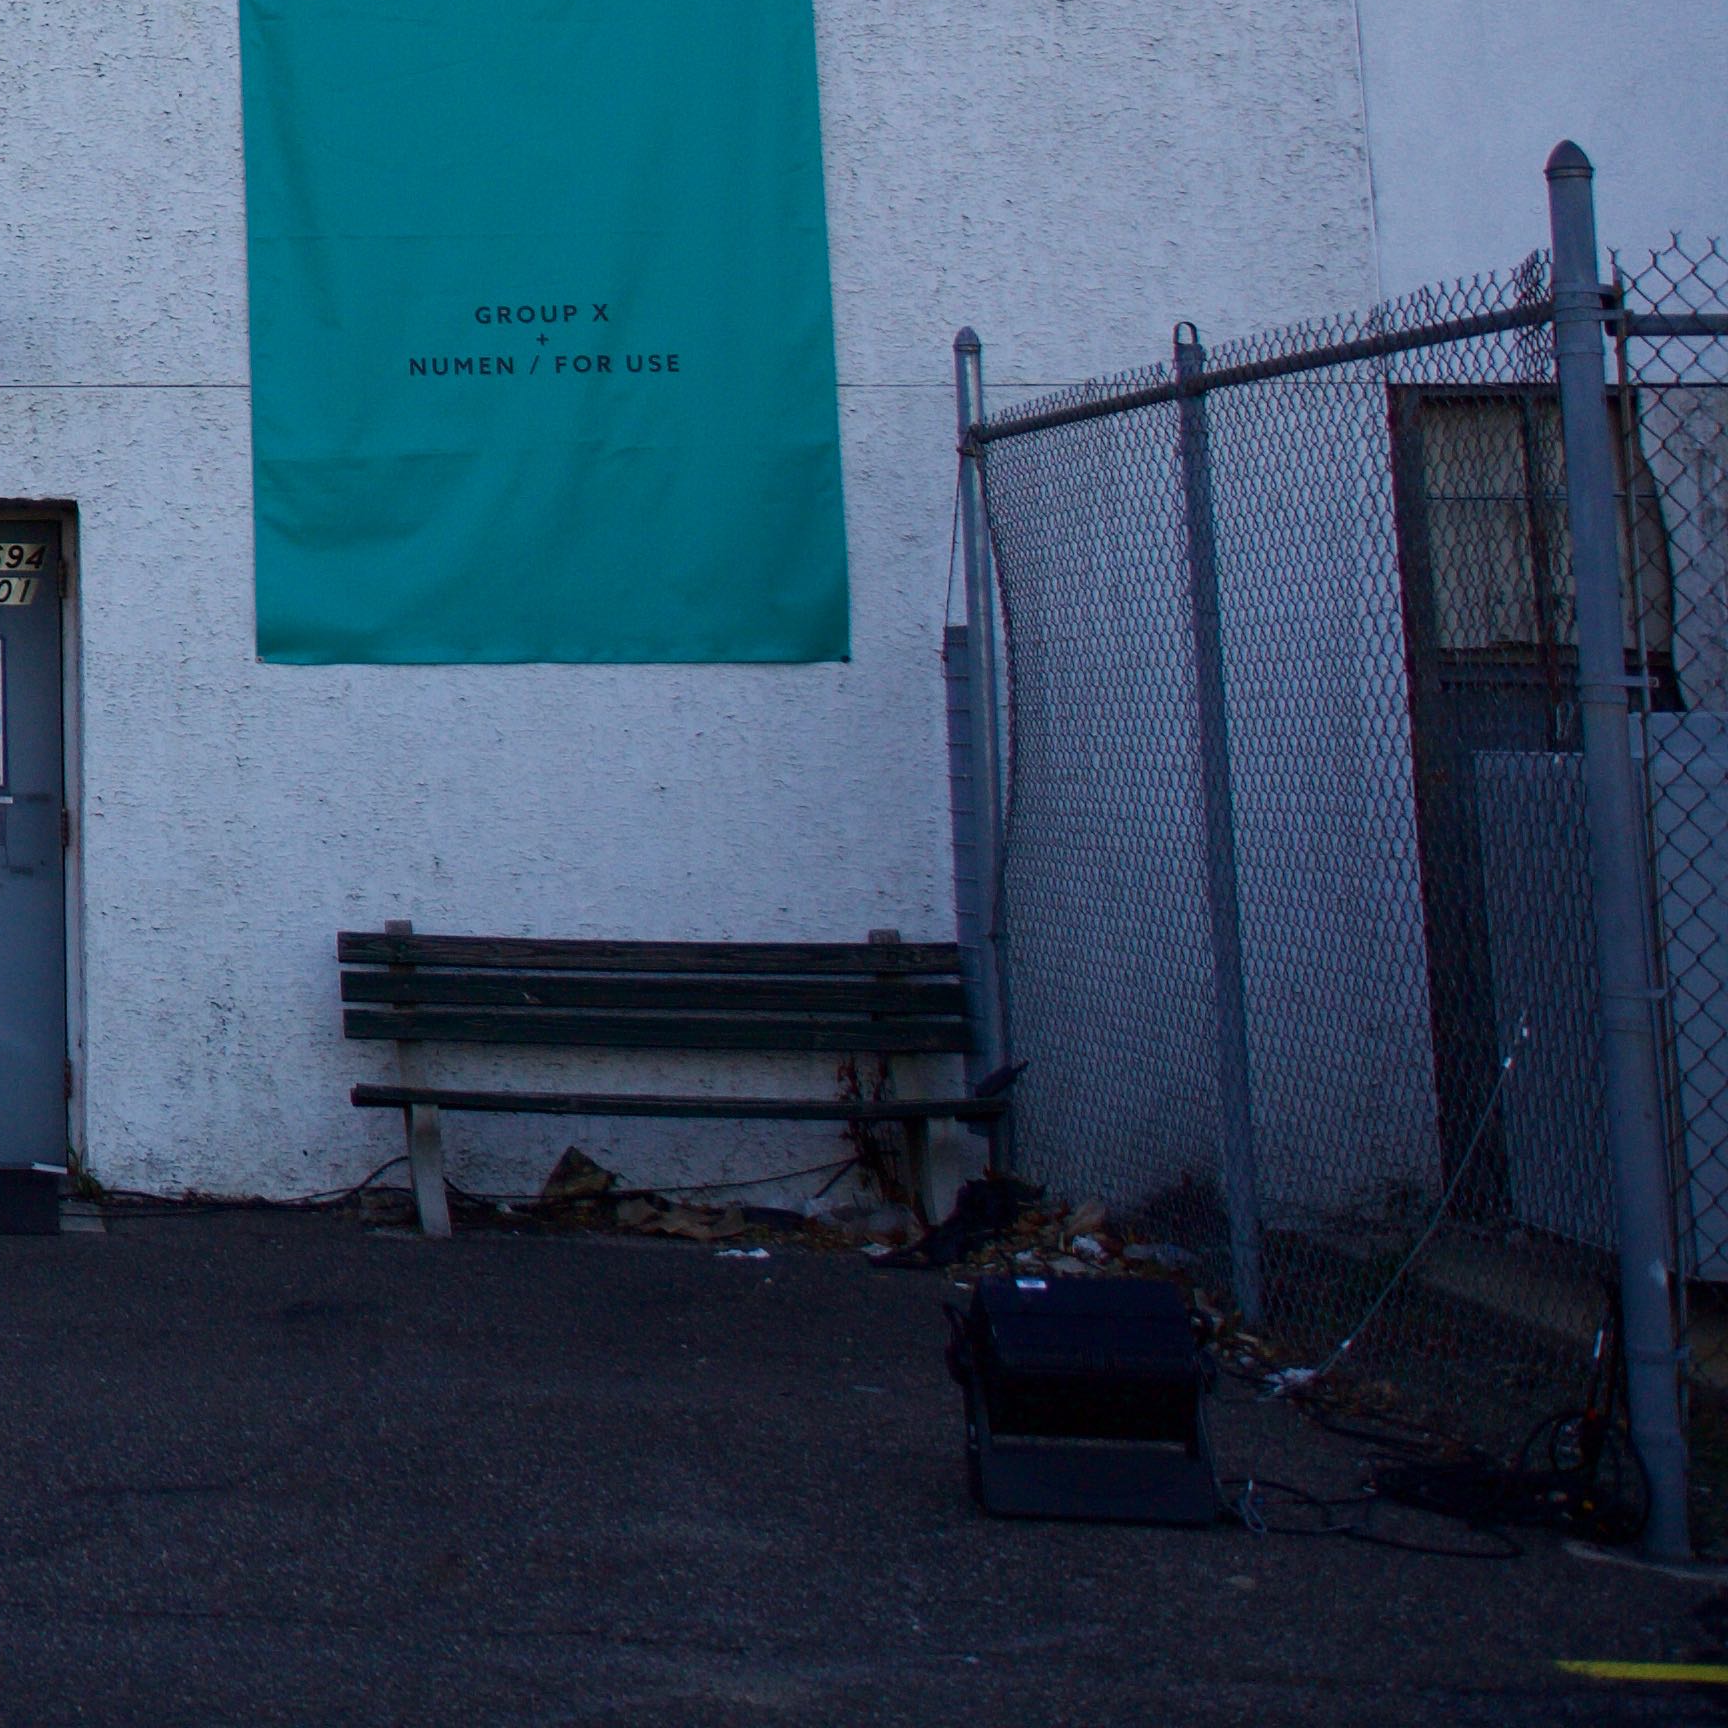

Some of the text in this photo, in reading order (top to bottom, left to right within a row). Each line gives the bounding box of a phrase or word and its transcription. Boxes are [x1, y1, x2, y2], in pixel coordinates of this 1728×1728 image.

[474, 303, 610, 325] GROUP X
[536, 333, 550, 346] +
[409, 353, 680, 377] NUMEN / FOR USE
